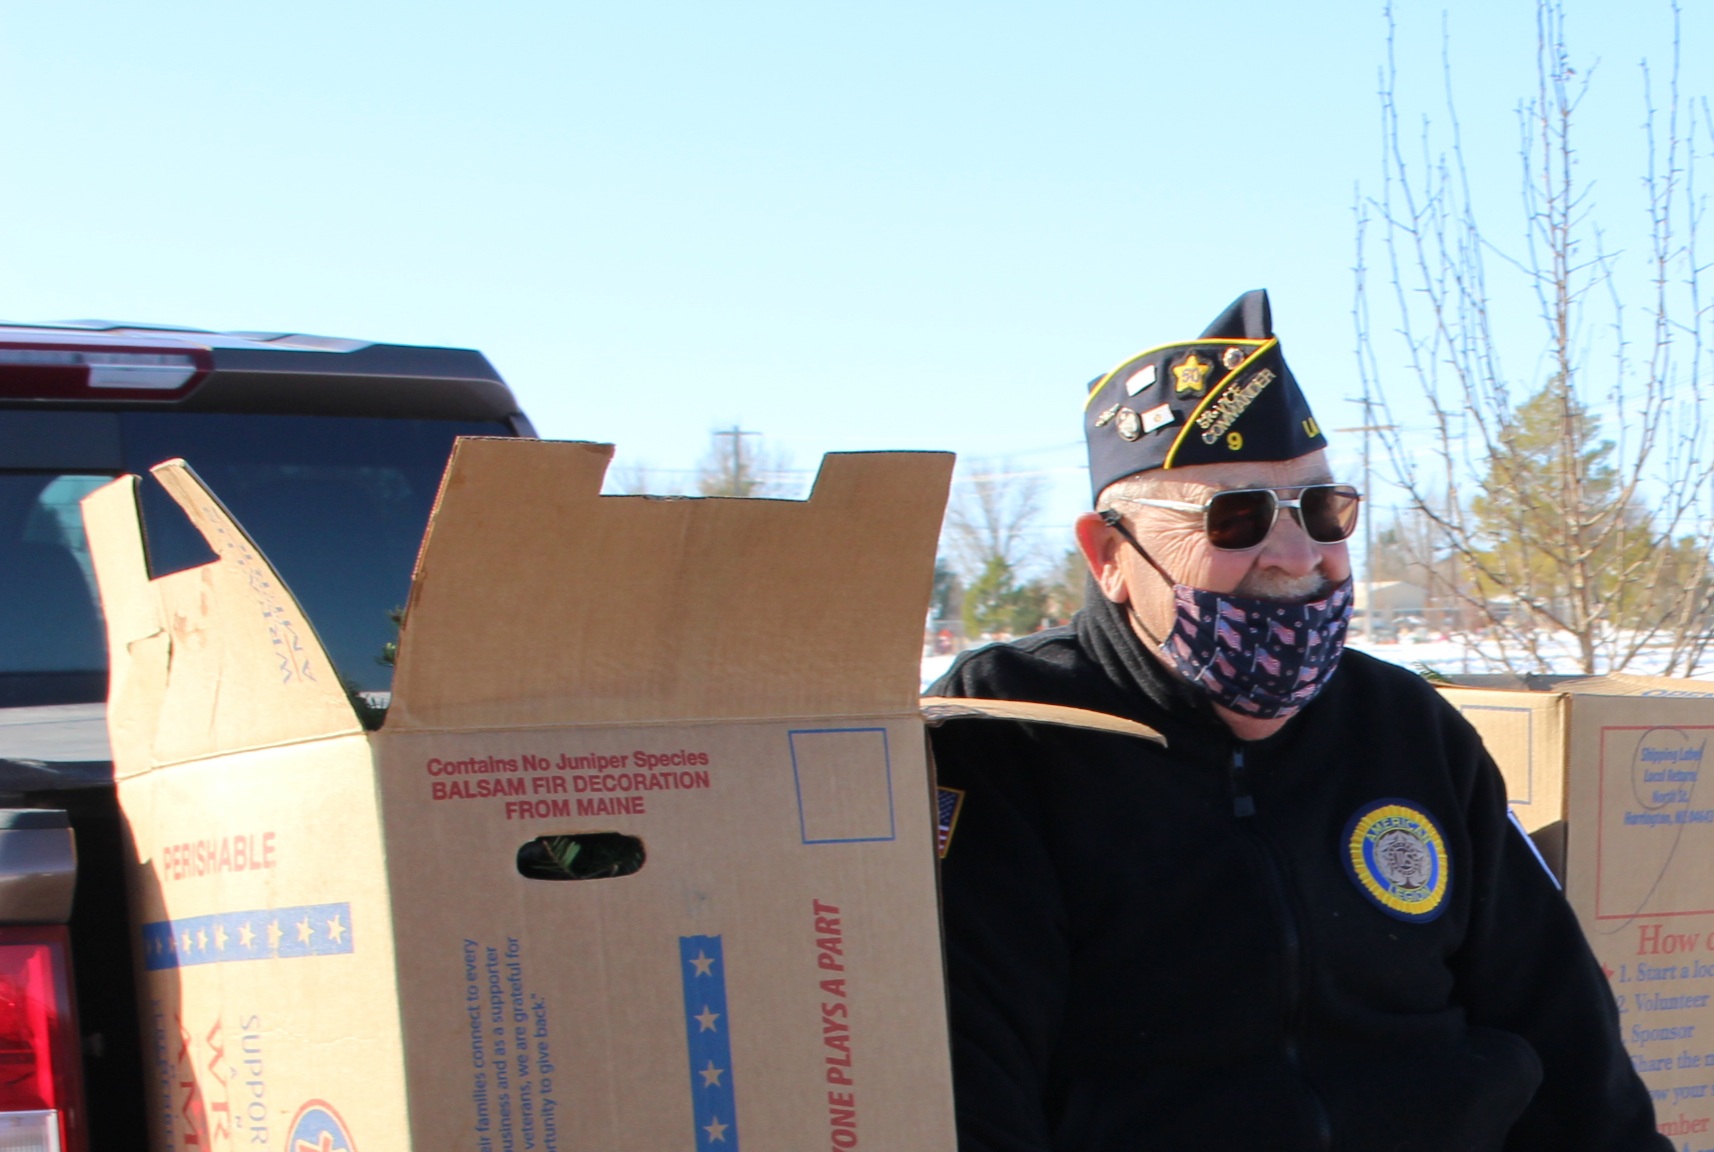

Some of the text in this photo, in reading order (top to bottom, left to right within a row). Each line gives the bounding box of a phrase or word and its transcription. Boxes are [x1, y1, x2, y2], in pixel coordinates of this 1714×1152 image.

[1201, 367, 1277, 445] COMMANDER
[1226, 431, 1243, 451] 9
[427, 749, 709, 776] Contains No Juniper Species
[431, 771, 710, 800] BALSAM FIR DECORATION
[505, 796, 645, 820] FROM MAINE
[163, 831, 277, 882] PERISHABLE
[505, 936, 520, 959] for
[813, 898, 845, 972] PART
[1636, 924, 1700, 955] How
[463, 938, 479, 981] every
[486, 946, 505, 1023] supporter
[1619, 964, 1631, 983] 1.
[1636, 962, 1678, 982] Start
[1680, 966, 1690, 979] a
[466, 984, 479, 1001] to
[505, 962, 529, 1023] grateful
[819, 978, 846, 997] A
[1634, 992, 1710, 1012] Volunteer
[466, 1005, 485, 1068] connect
[492, 1026, 505, 1036] a
[515, 1026, 528, 1050] are
[1631, 1024, 1696, 1047] Sponsor
[493, 1039, 506, 1056] as
[822, 1002, 854, 1086] PLAYS
[517, 1054, 530, 1077] we
[536, 1041, 556, 1075] give
[1677, 1051, 1700, 1069] the
[491, 1060, 509, 1089] and
[540, 1077, 552, 1094] to
[472, 1072, 491, 1132] families
[1673, 1083, 1709, 1105] your
[519, 1080, 536, 1150] veterans,
